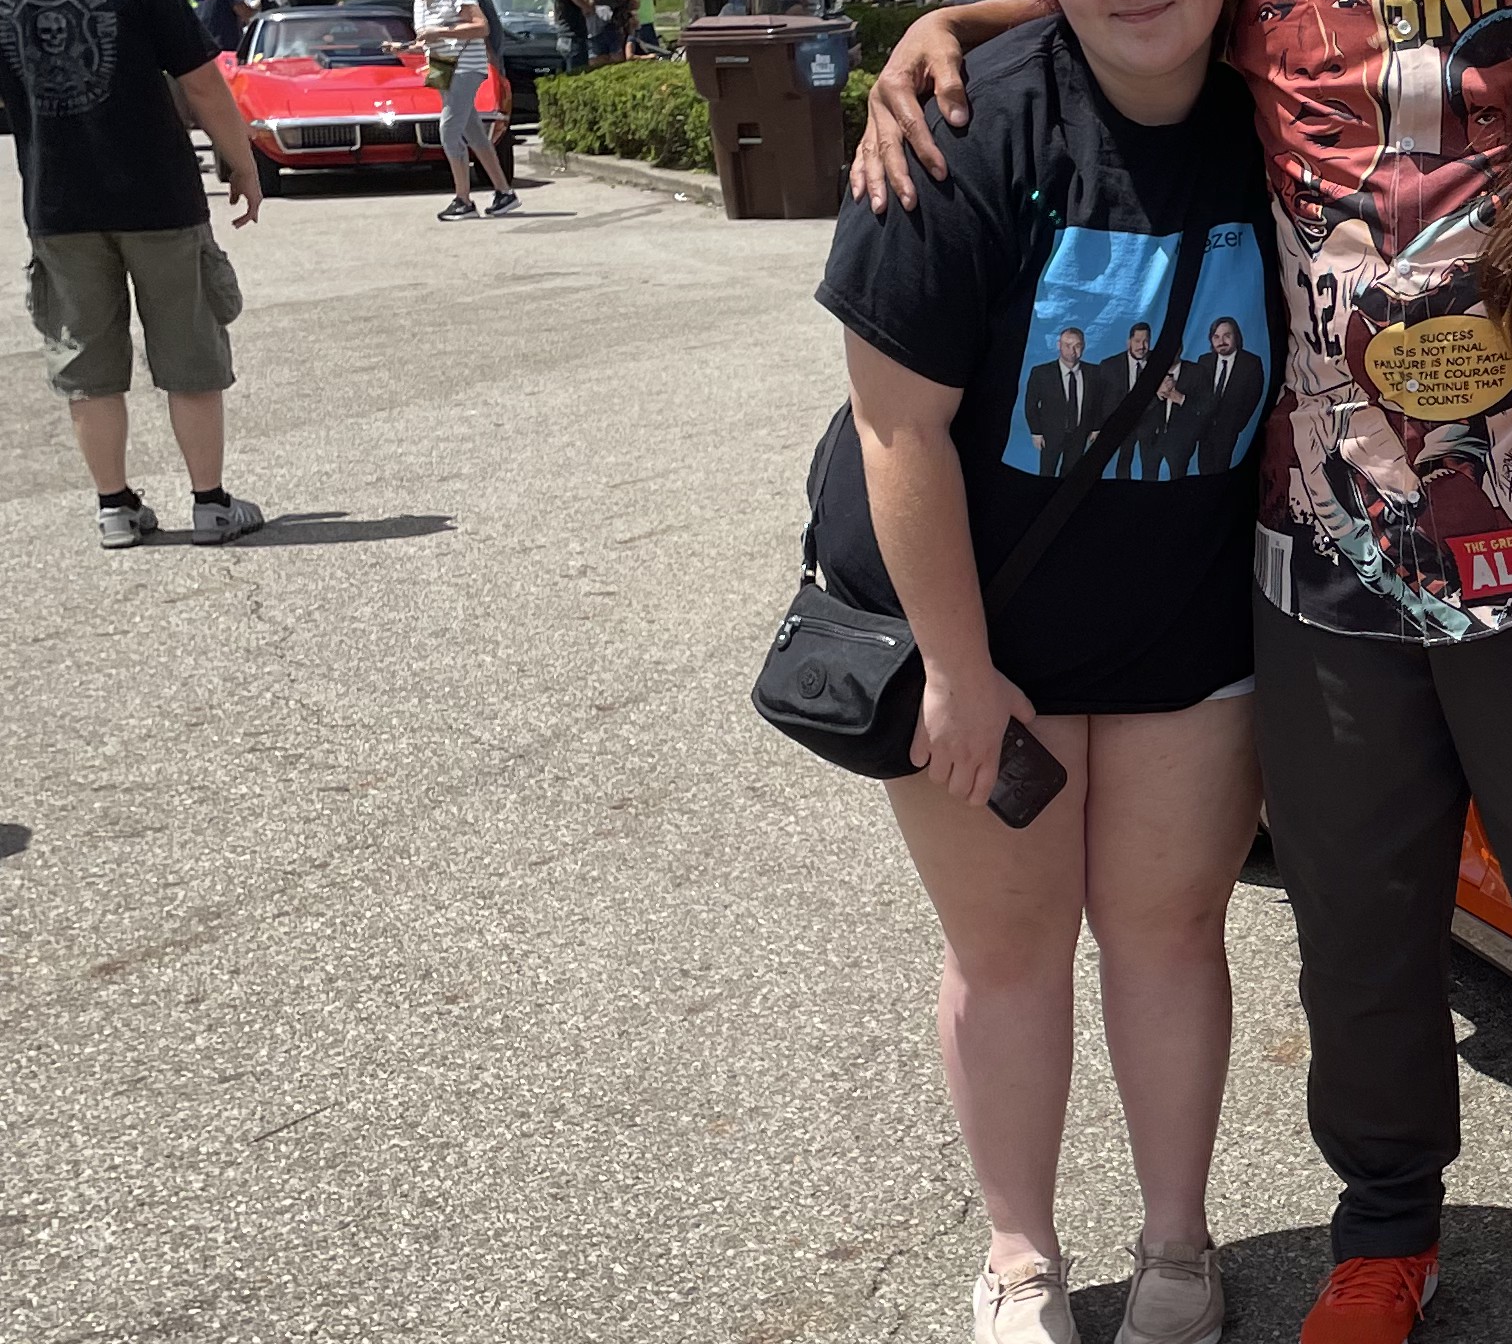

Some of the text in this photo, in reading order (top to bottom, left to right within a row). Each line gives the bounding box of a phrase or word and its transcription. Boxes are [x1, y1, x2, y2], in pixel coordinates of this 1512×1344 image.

[1419, 329, 1475, 345] SUCCESS
[1420, 345, 1448, 357] NOT
[1451, 342, 1488, 354] FINAL
[1431, 357, 1442, 368] IS
[1446, 355, 1473, 367] NOT
[1476, 351, 1512, 365] FATAL
[1418, 369, 1440, 381] THE
[1444, 363, 1507, 379] COURAGE
[1406, 379, 1471, 393] ONTINUE
[1474, 376, 1506, 390] THAT
[1417, 392, 1475, 407] COUNTS!
[1464, 540, 1488, 554] THE
